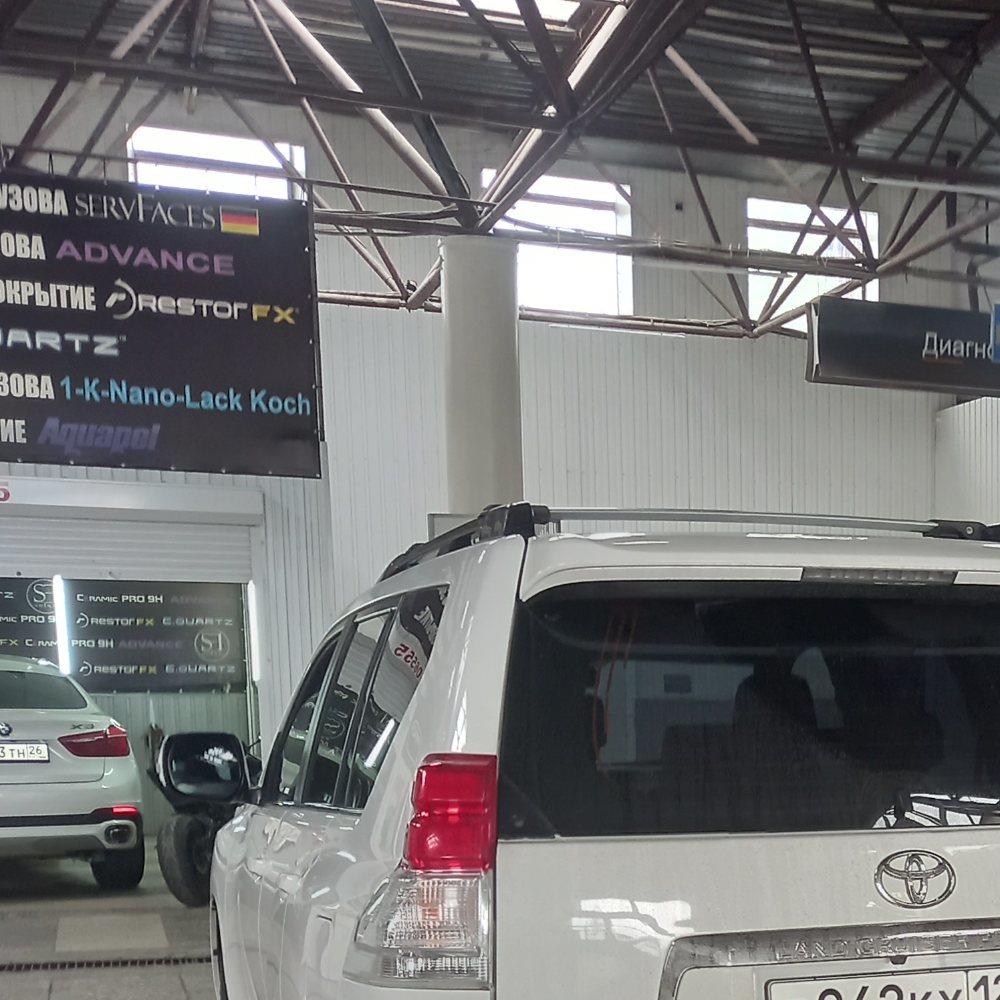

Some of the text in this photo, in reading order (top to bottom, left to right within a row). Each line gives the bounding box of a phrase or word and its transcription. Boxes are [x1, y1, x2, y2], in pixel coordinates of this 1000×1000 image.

[56, 240, 235, 276] ADVANCE
[0, 328, 119, 356] ARTZ
[60, 375, 243, 412] 1-K-Nano-Lack
[250, 389, 311, 416] Koch
[121, 594, 145, 603] PRO
[147, 594, 163, 603] 9H
[20, 615, 45, 623] PRO
[71, 639, 95, 648] PRO
[98, 639, 114, 649] 9H
[28, 746, 43, 755] 26
